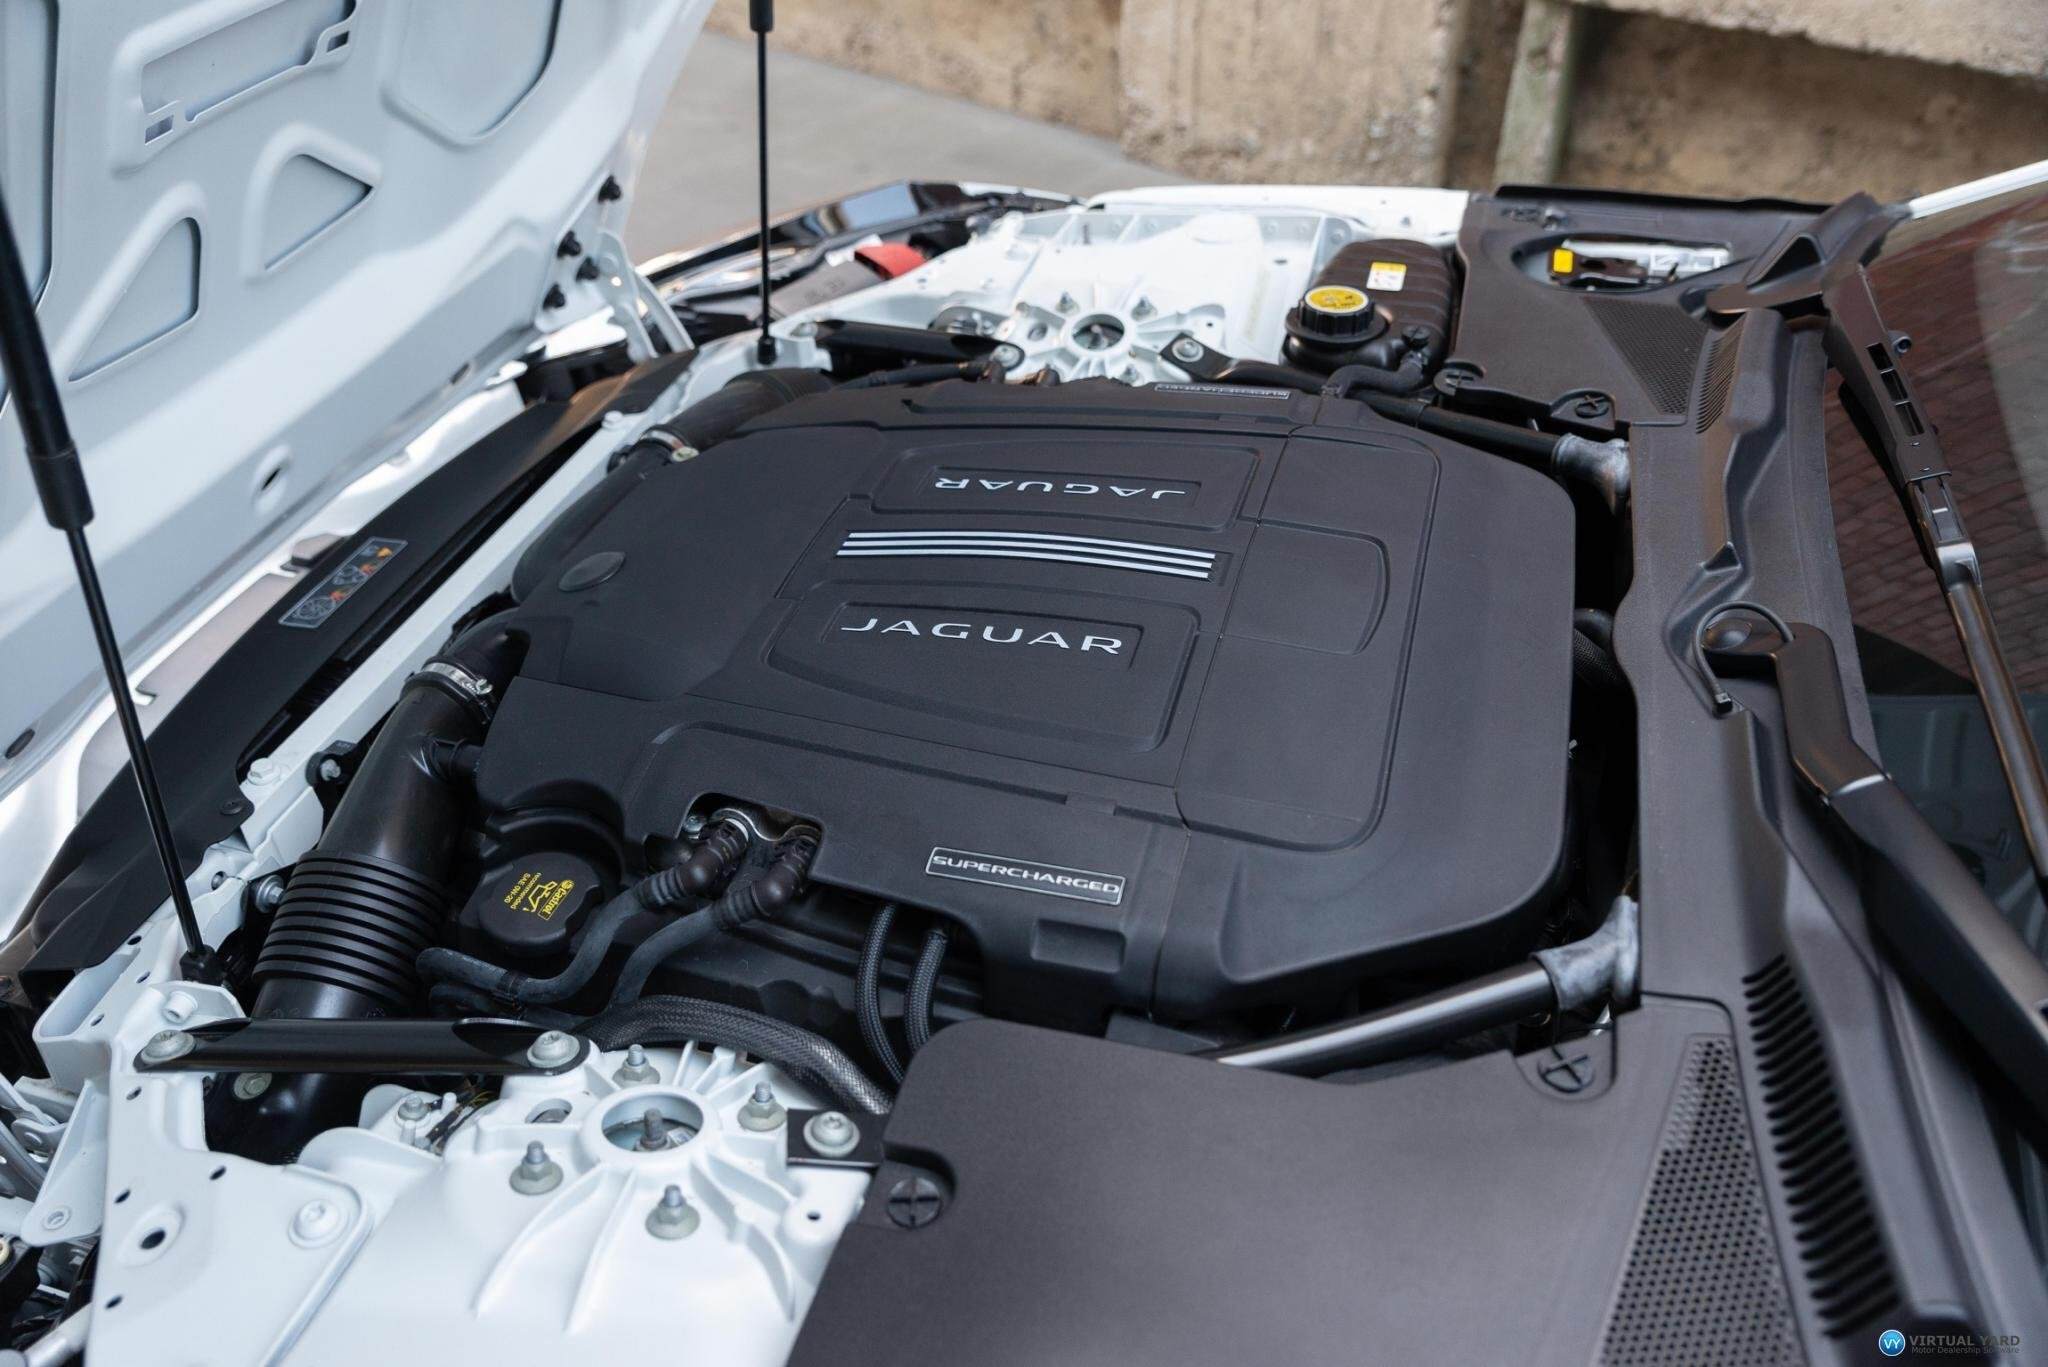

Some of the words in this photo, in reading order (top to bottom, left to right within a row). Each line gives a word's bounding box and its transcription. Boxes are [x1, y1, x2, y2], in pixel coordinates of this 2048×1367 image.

[935, 476, 1187, 499] JAGUAR
[841, 618, 1122, 655] JAGUAR
[517, 872, 531, 887] SAE
[932, 855, 1120, 893] SUPERCHARGED
[542, 886, 567, 914] Castrol
